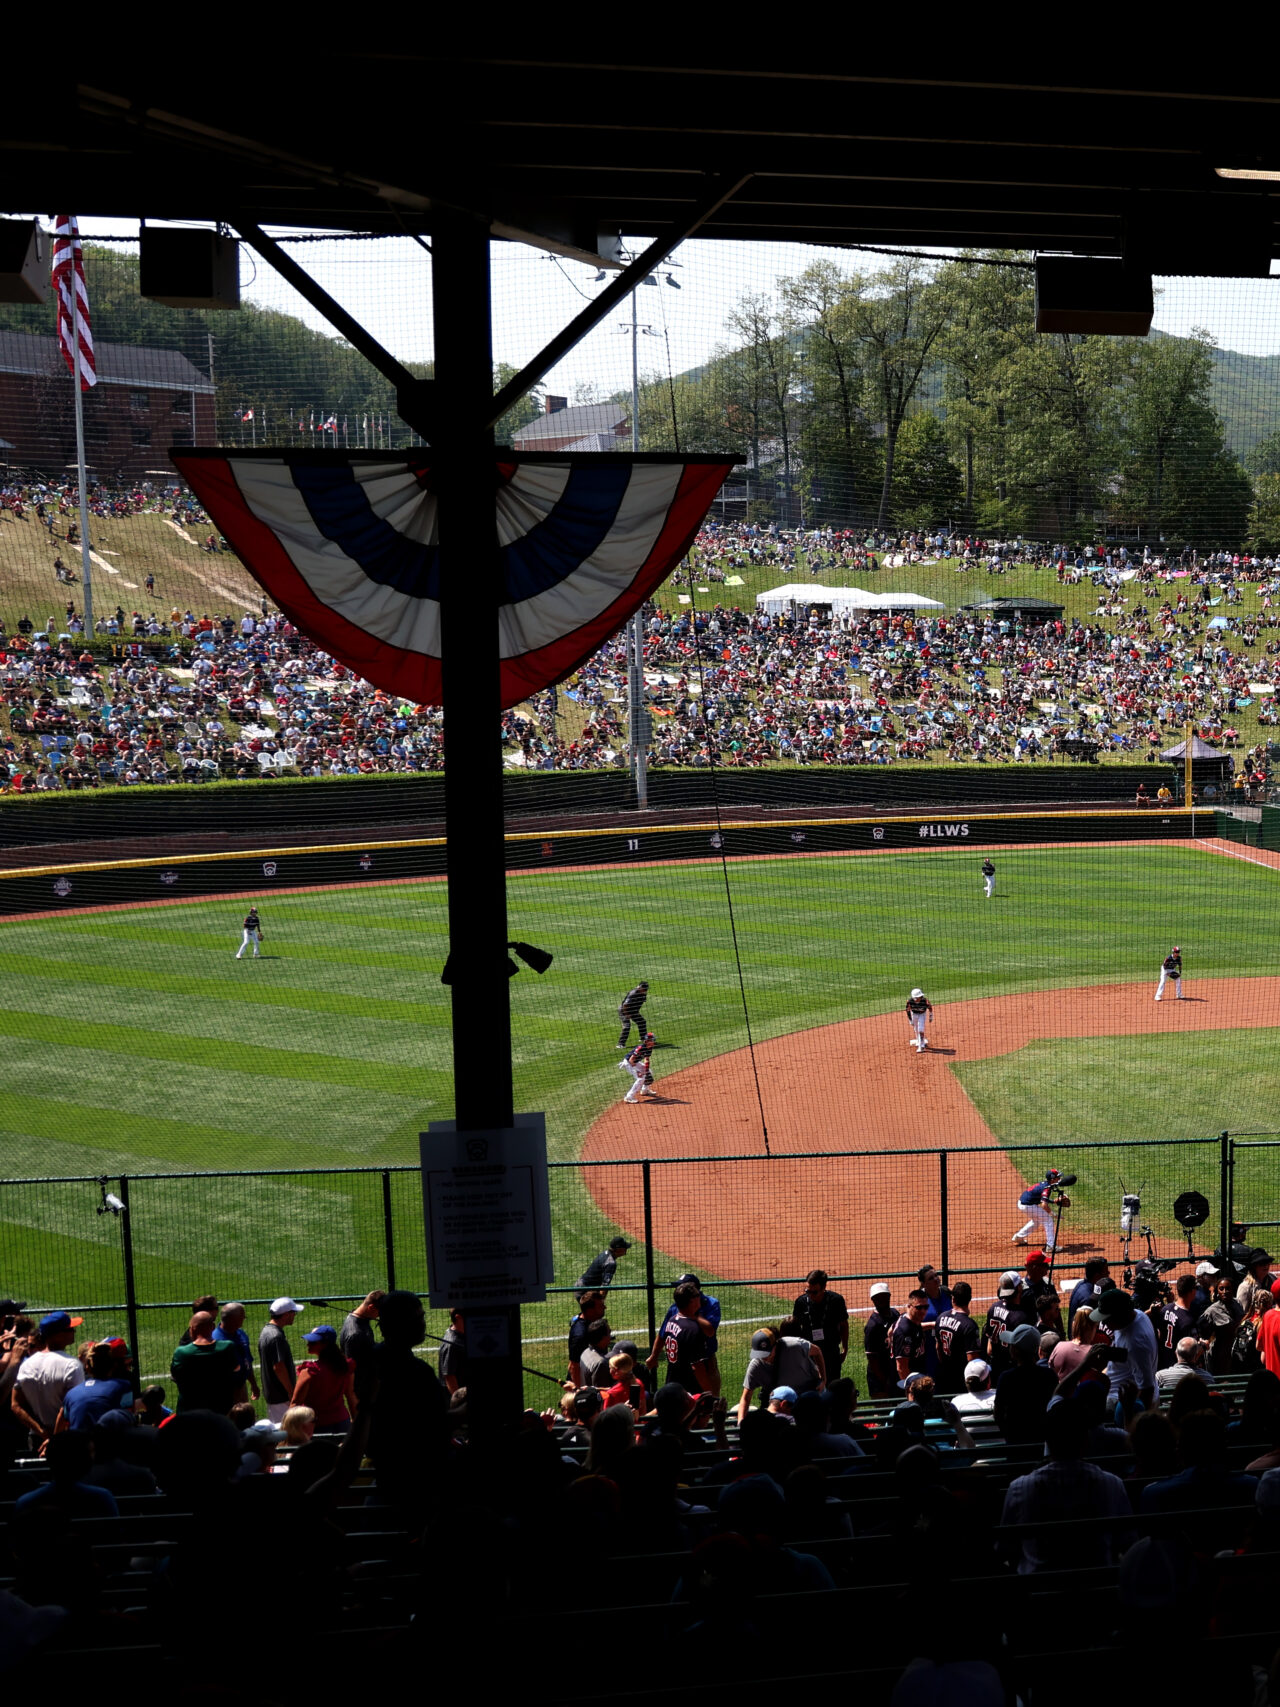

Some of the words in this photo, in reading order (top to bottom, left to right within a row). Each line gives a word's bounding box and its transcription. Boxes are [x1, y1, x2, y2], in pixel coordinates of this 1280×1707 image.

[919, 823, 969, 838] #LLWS
[627, 839, 639, 851] 11
[939, 1316, 961, 1332] GARCIA
[1164, 1324, 1174, 1349] 1
